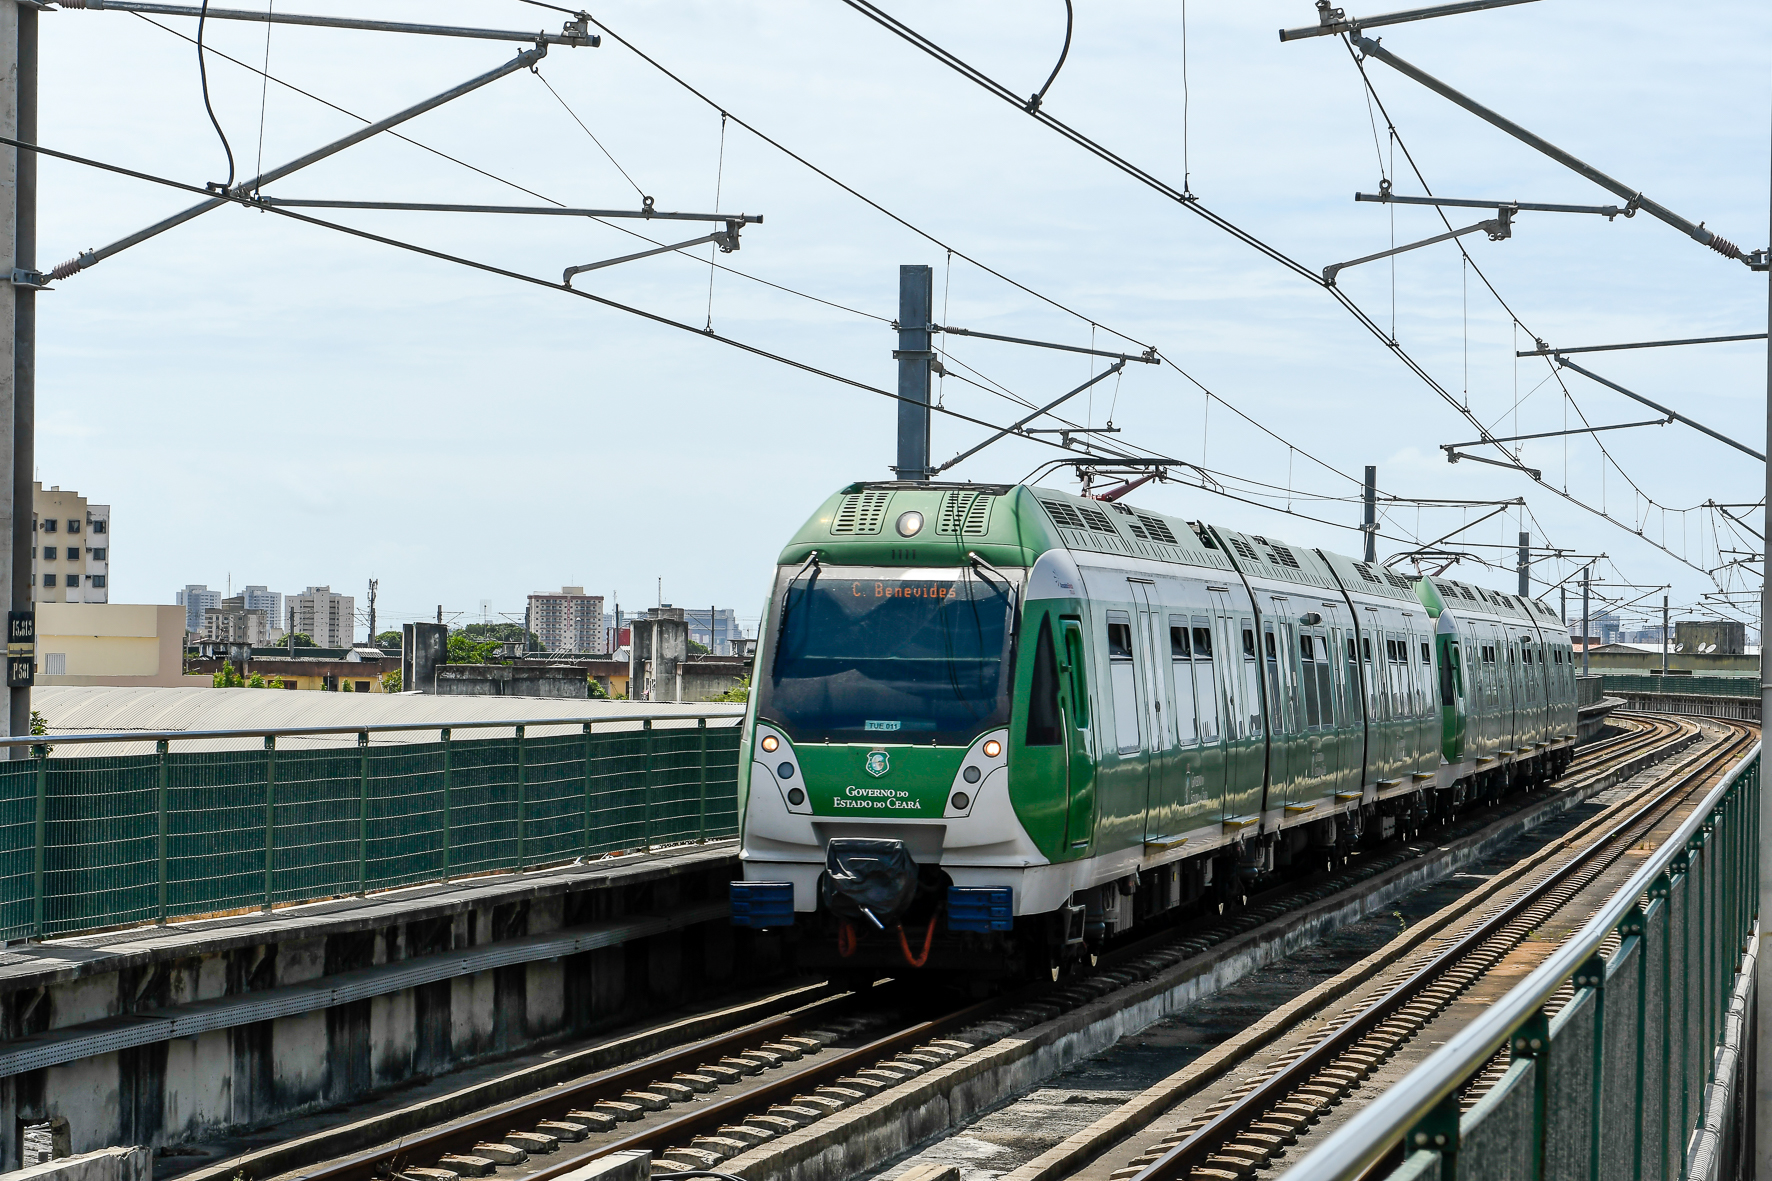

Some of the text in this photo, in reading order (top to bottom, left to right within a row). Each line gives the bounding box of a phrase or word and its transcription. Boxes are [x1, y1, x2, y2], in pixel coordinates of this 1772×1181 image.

[852, 582, 956, 598] C. Benevides
[13, 663, 18, 680] P
[845, 785, 909, 798] GOVERNO DO
[833, 796, 921, 809] ESTADO DO CEARÁ
